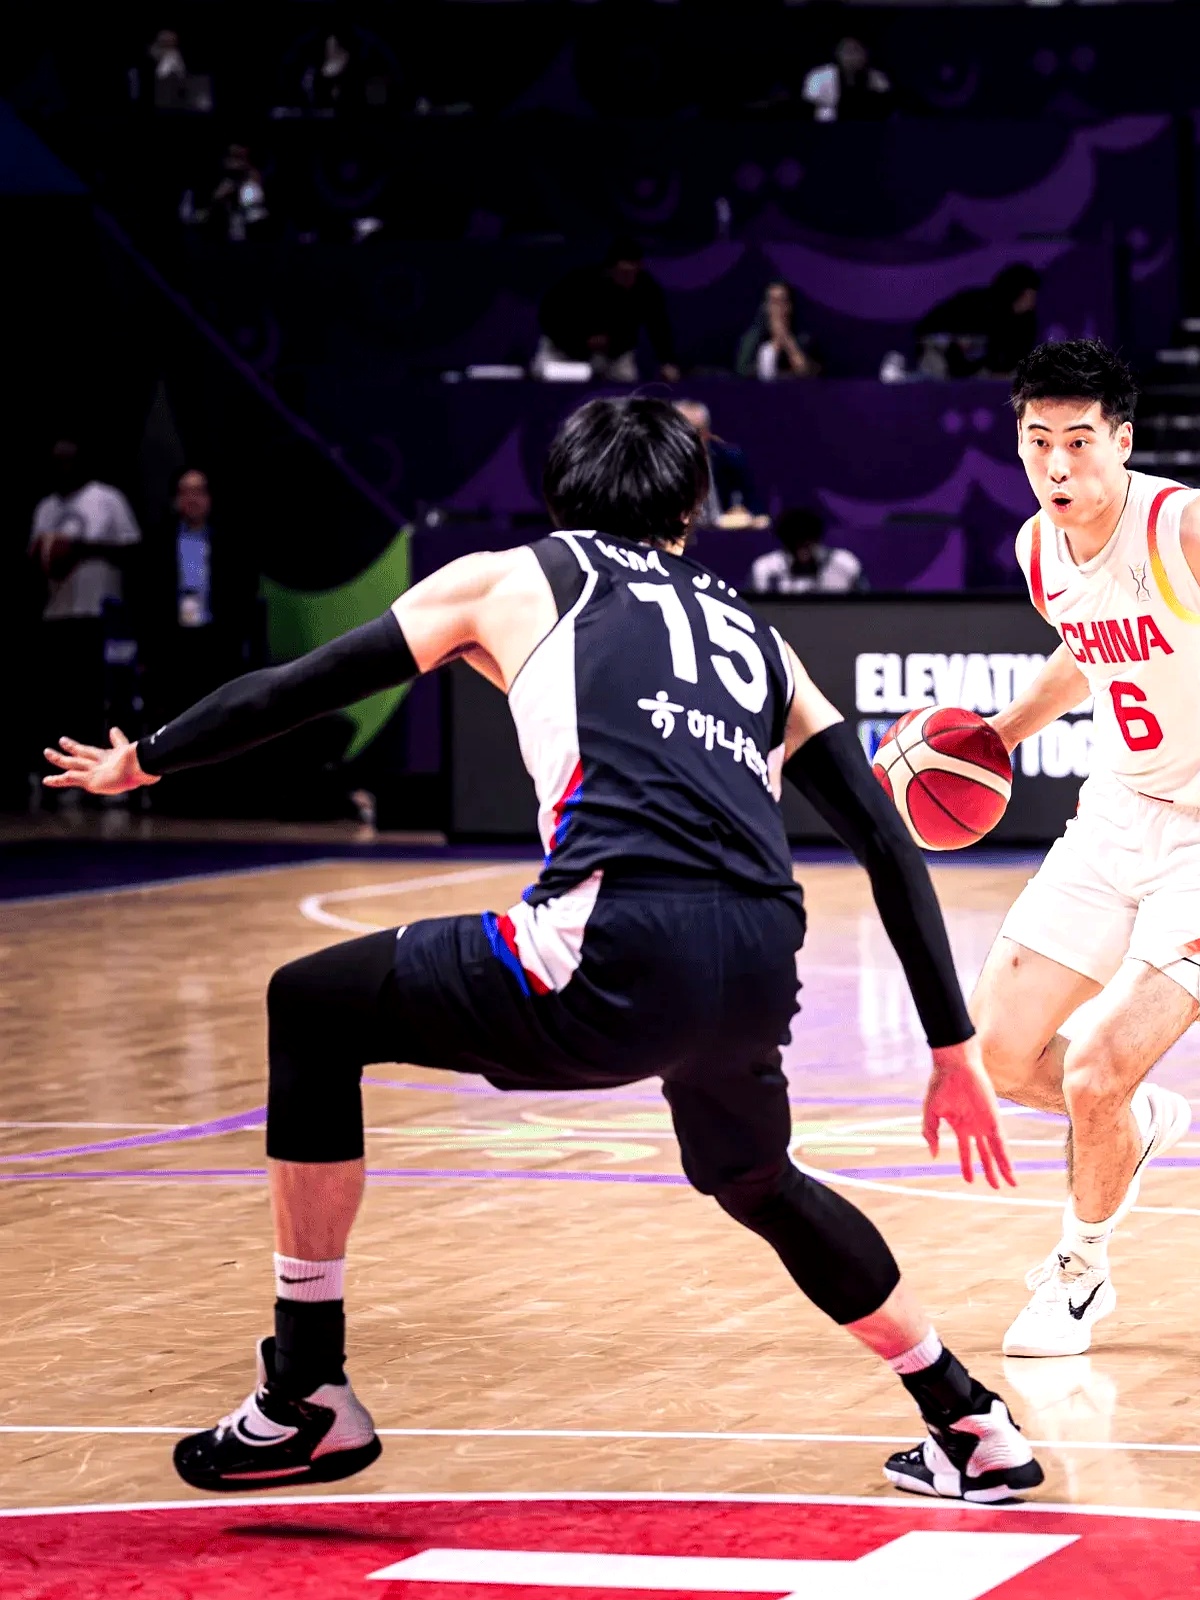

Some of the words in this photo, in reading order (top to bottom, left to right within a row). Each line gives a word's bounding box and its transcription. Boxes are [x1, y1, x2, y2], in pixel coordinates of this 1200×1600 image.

[628, 582, 769, 714] 75
[1062, 614, 1175, 665] CHINA
[1109, 681, 1164, 752] 6
